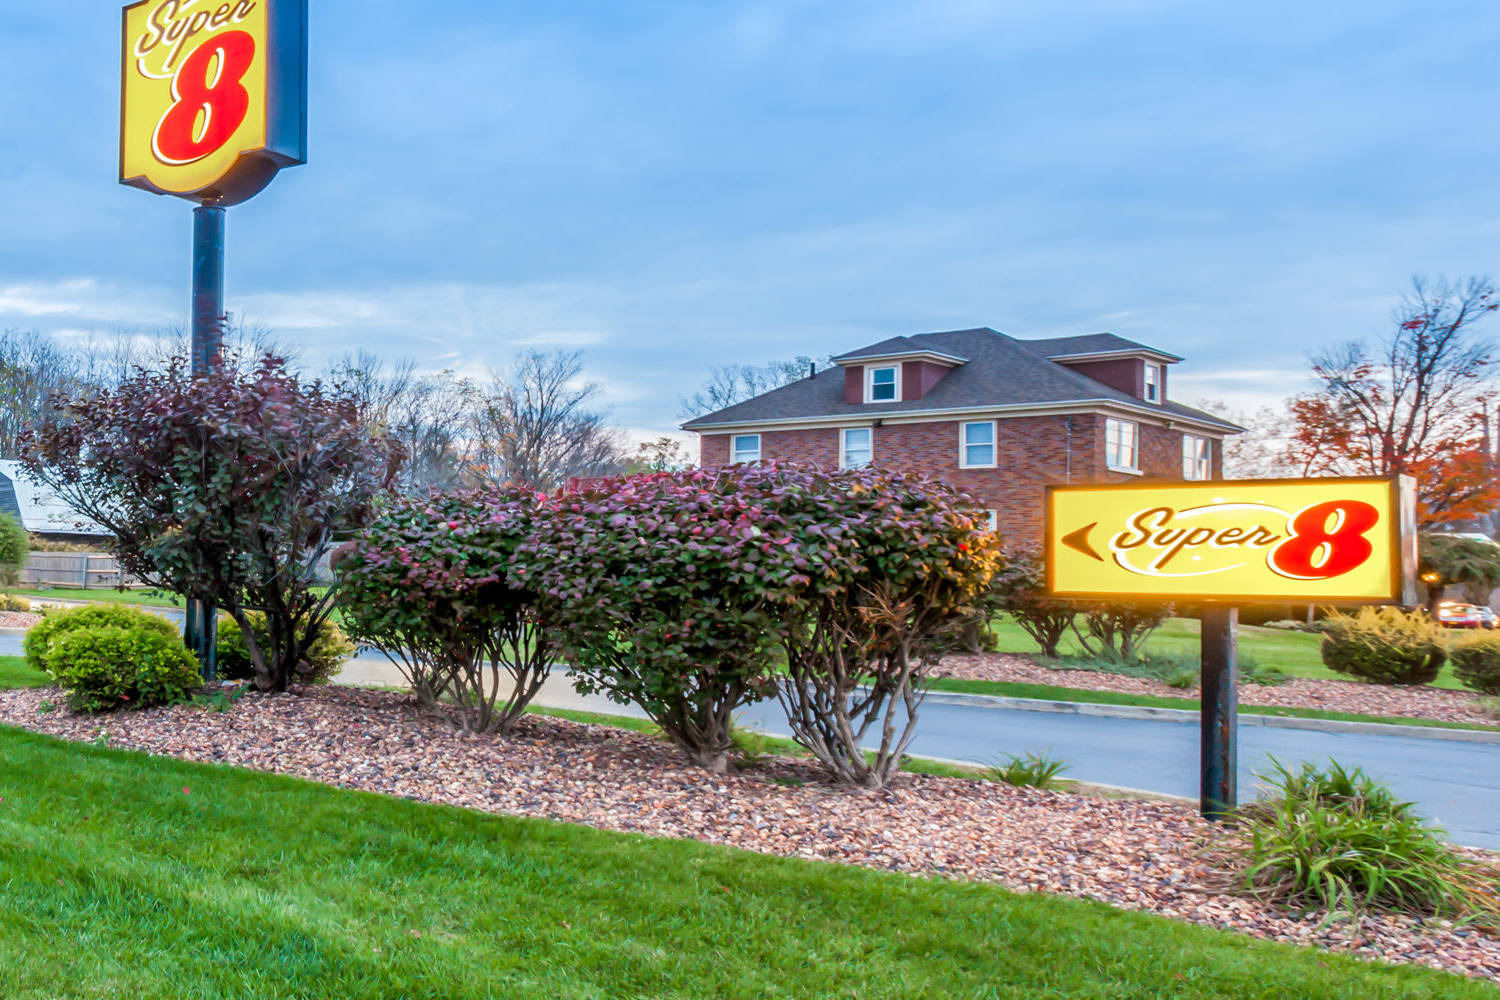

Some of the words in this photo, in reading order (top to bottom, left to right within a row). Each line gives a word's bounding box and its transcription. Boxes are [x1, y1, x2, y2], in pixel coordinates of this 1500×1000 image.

[152, 29, 256, 166] 8
[1109, 506, 1281, 573] Super
[1267, 499, 1380, 580] 8
